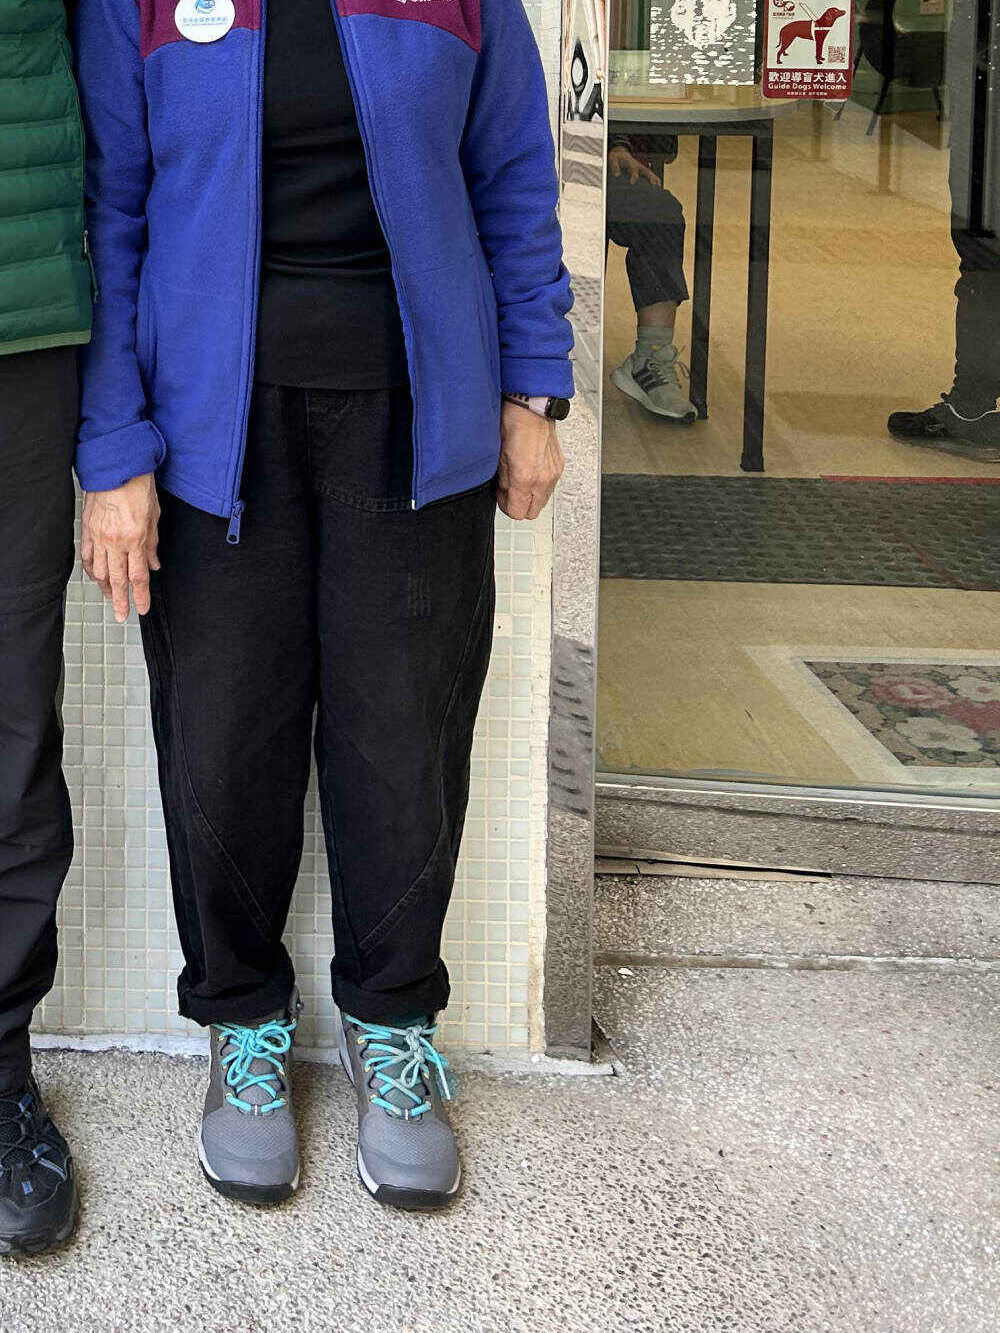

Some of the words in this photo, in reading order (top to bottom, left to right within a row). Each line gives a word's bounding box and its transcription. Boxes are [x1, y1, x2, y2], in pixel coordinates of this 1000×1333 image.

[768, 71, 847, 83] 歡迎導盲犬進入
[768, 82, 791, 90] Guide
[792, 83, 812, 91] Dogs
[813, 82, 847, 90] Welcome
